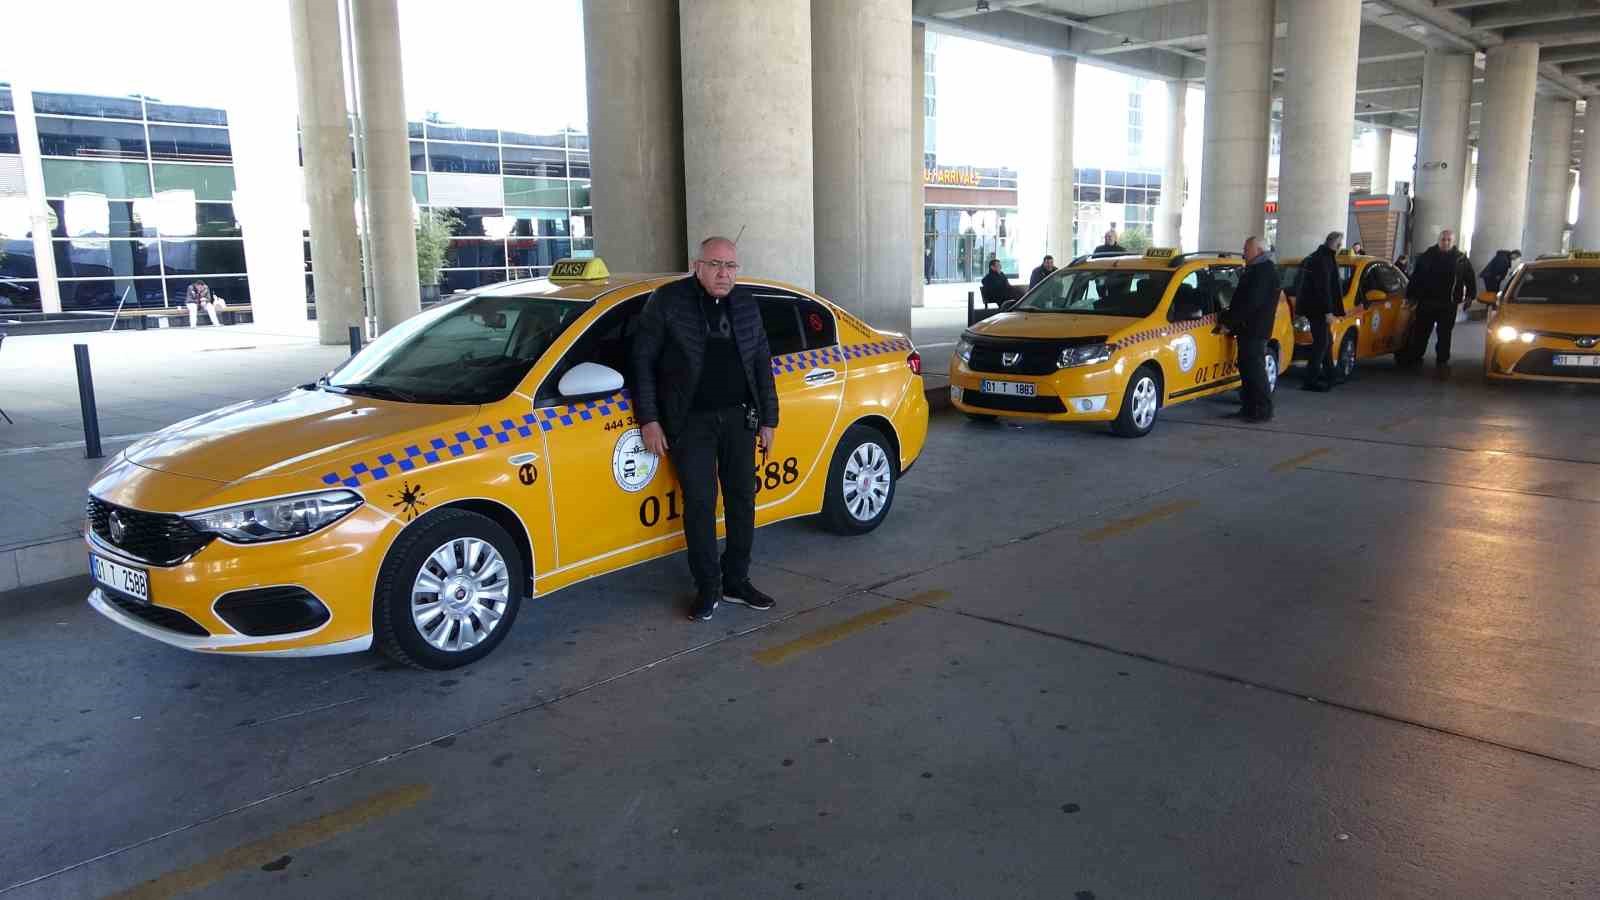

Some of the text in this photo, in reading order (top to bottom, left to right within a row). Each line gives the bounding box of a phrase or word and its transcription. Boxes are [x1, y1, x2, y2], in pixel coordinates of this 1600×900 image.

[1195, 366, 1208, 384] 01
[1212, 363, 1219, 379] T
[986, 381, 997, 392] 01
[1002, 382, 1008, 392] T
[604, 419, 624, 431] 444
[520, 466, 536, 482] 11
[639, 490, 681, 527] 01
[96, 559, 146, 596] 01 T 2588
